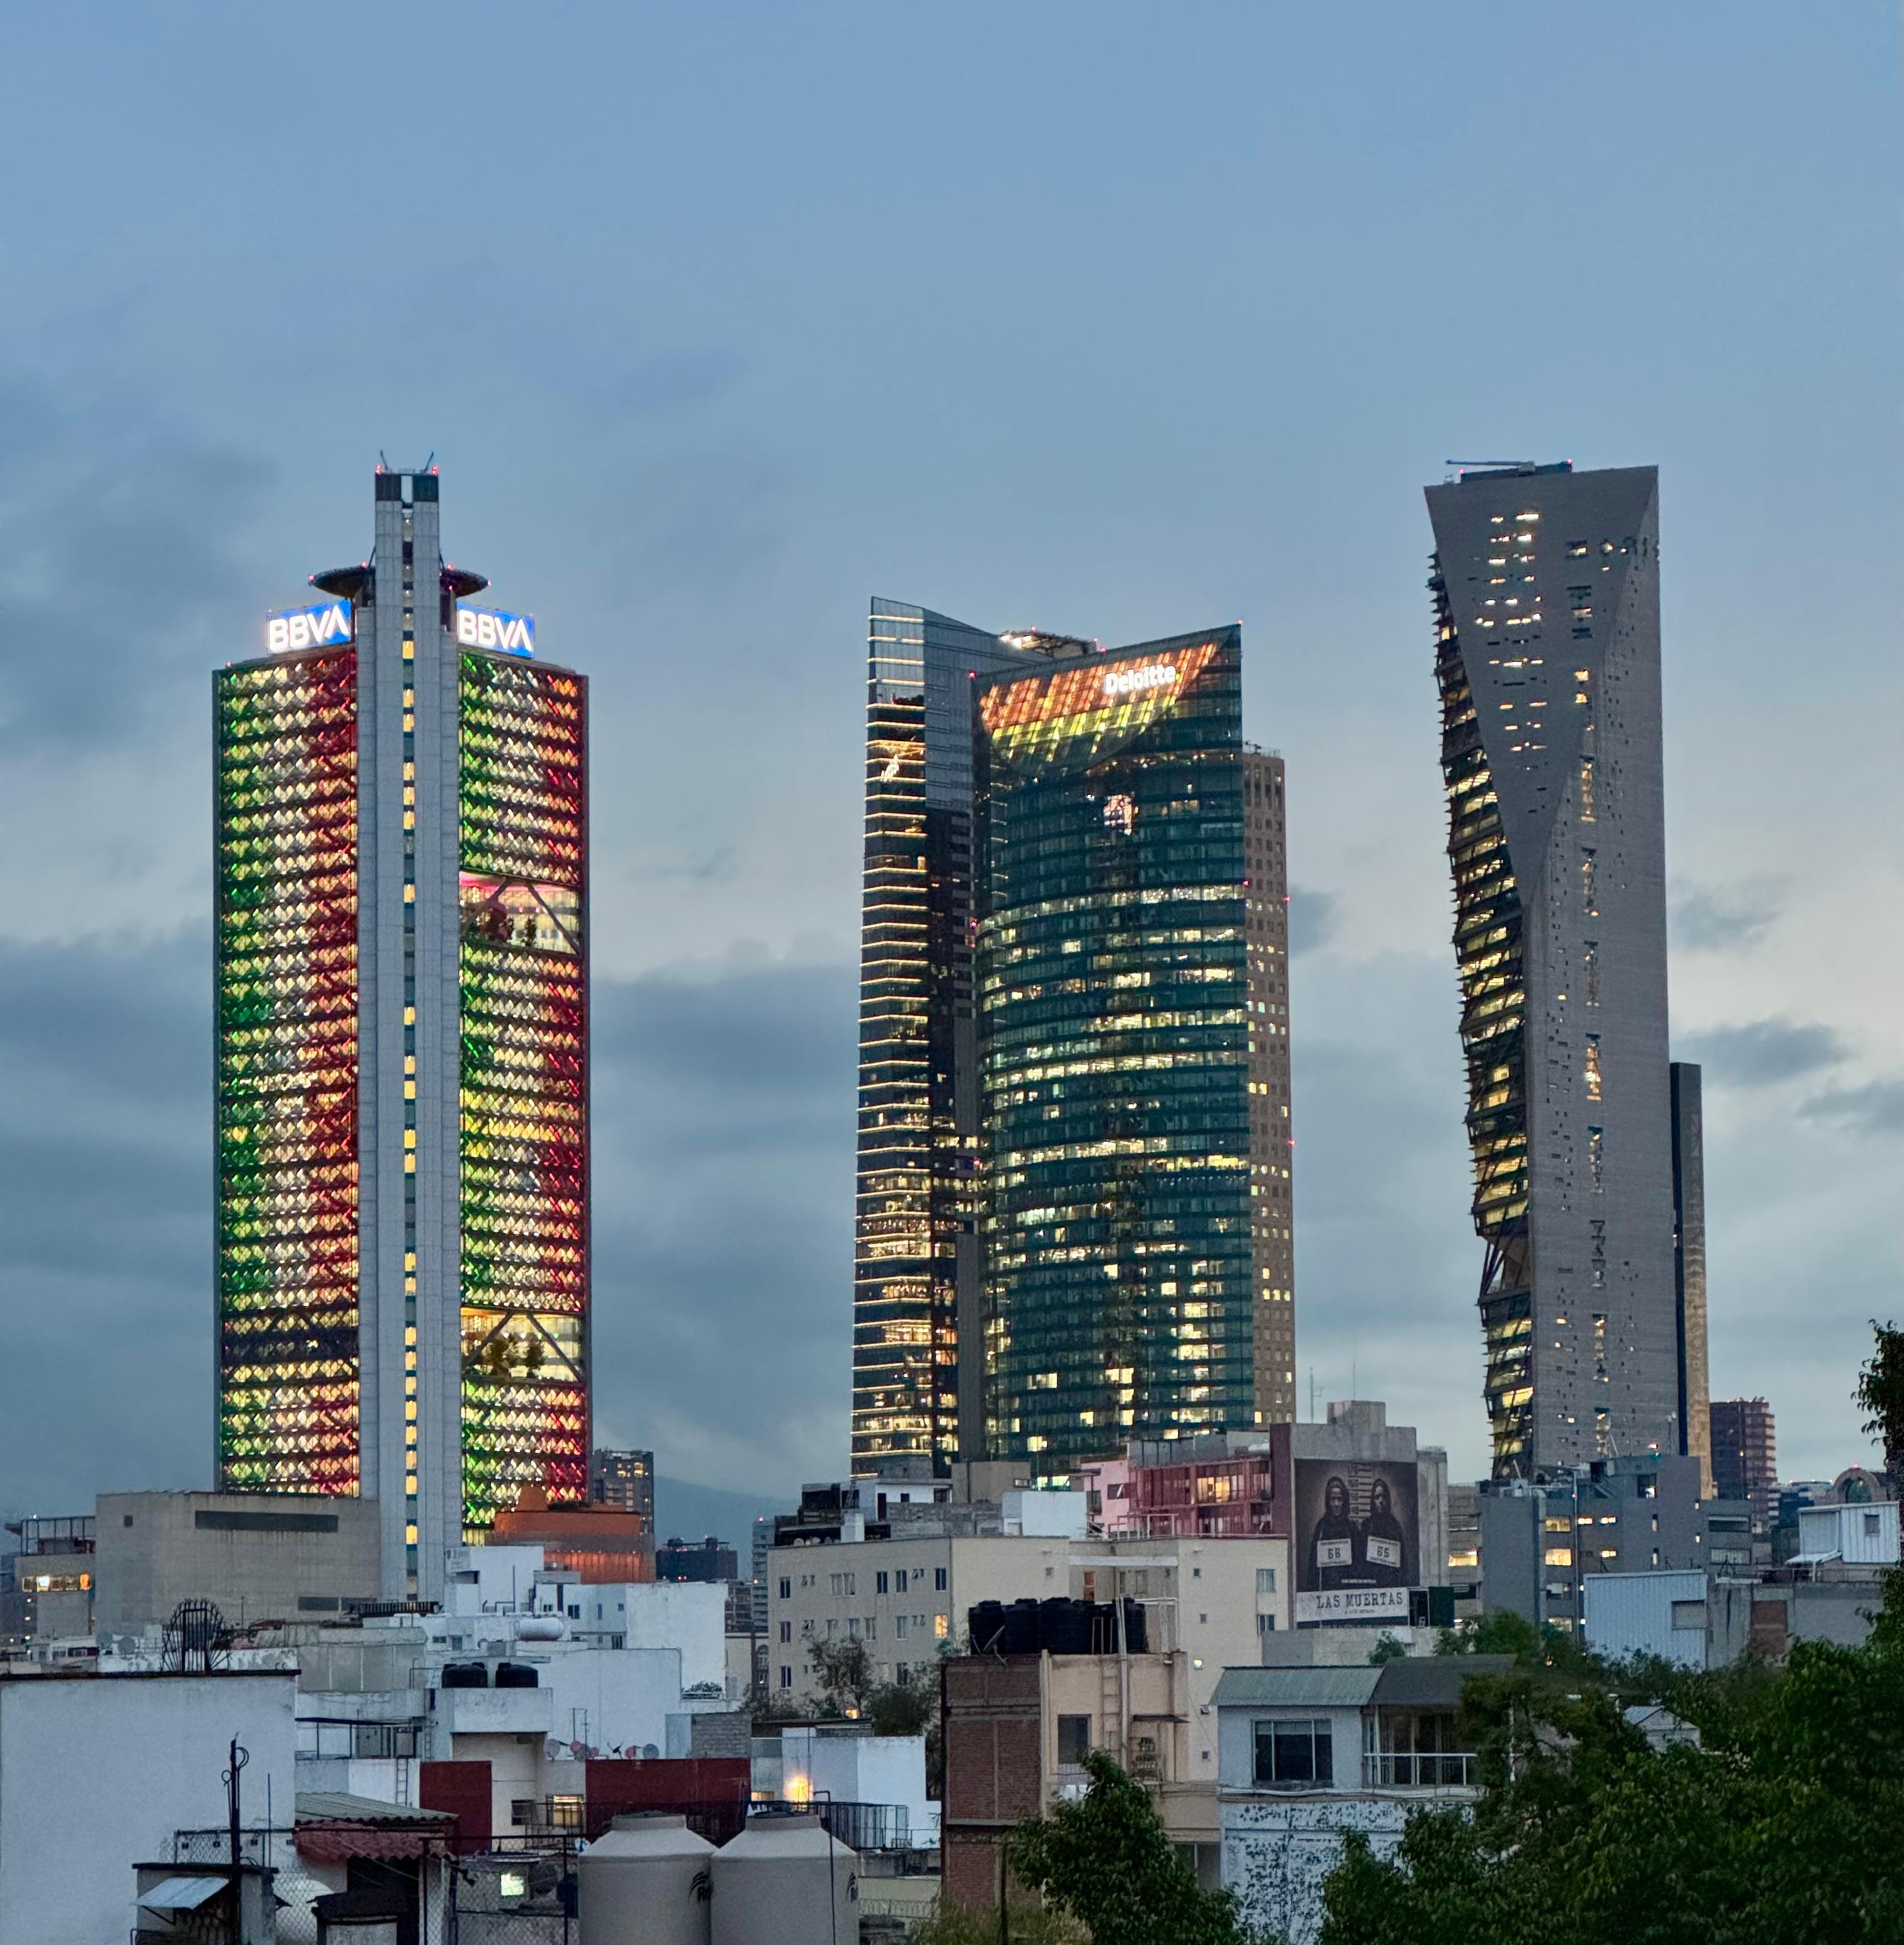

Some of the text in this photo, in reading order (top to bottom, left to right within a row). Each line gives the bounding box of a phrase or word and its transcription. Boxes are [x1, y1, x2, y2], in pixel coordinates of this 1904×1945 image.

[268, 605, 349, 651] BBVA
[459, 609, 533, 651] BBVA
[1316, 1592, 1403, 1609] LAS MUERTAS
